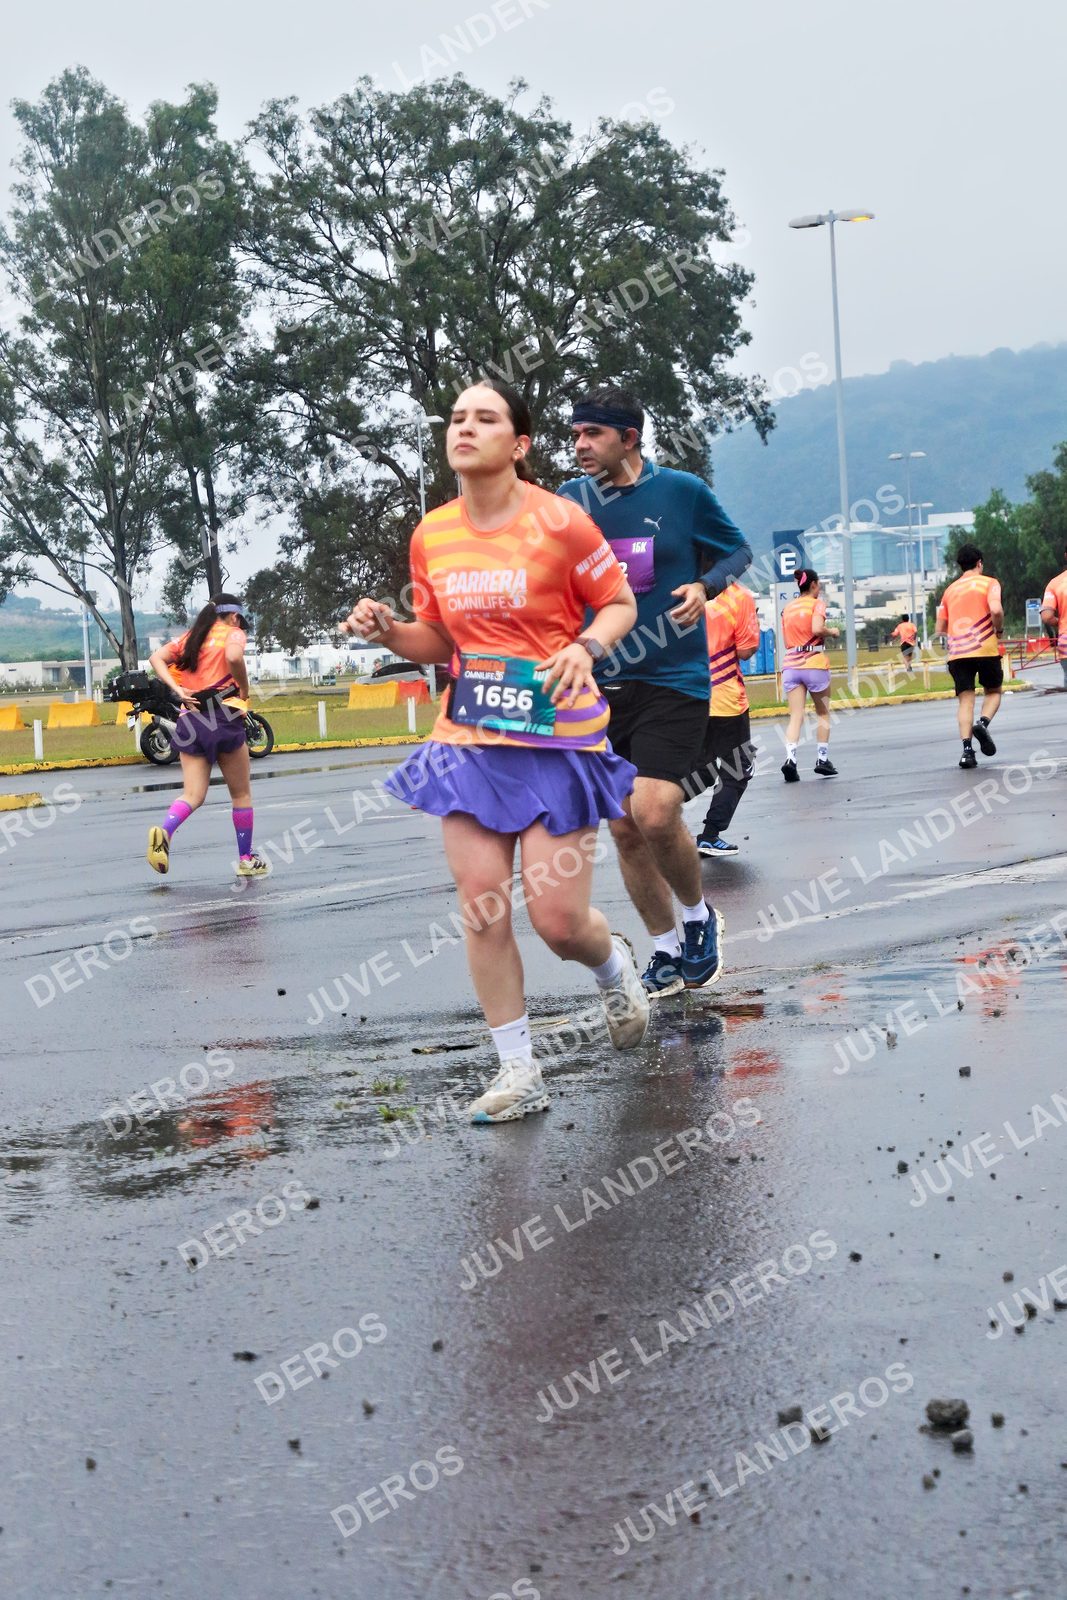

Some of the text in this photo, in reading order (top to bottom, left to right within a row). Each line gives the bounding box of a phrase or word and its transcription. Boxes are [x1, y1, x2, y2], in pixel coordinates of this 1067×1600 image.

[781, 552, 796, 575] E
[446, 568, 527, 594] CARRERA
[447, 595, 507, 612] OMNILIFE
[464, 670, 495, 681] OMNILIFE
[473, 685, 533, 711] 1656
